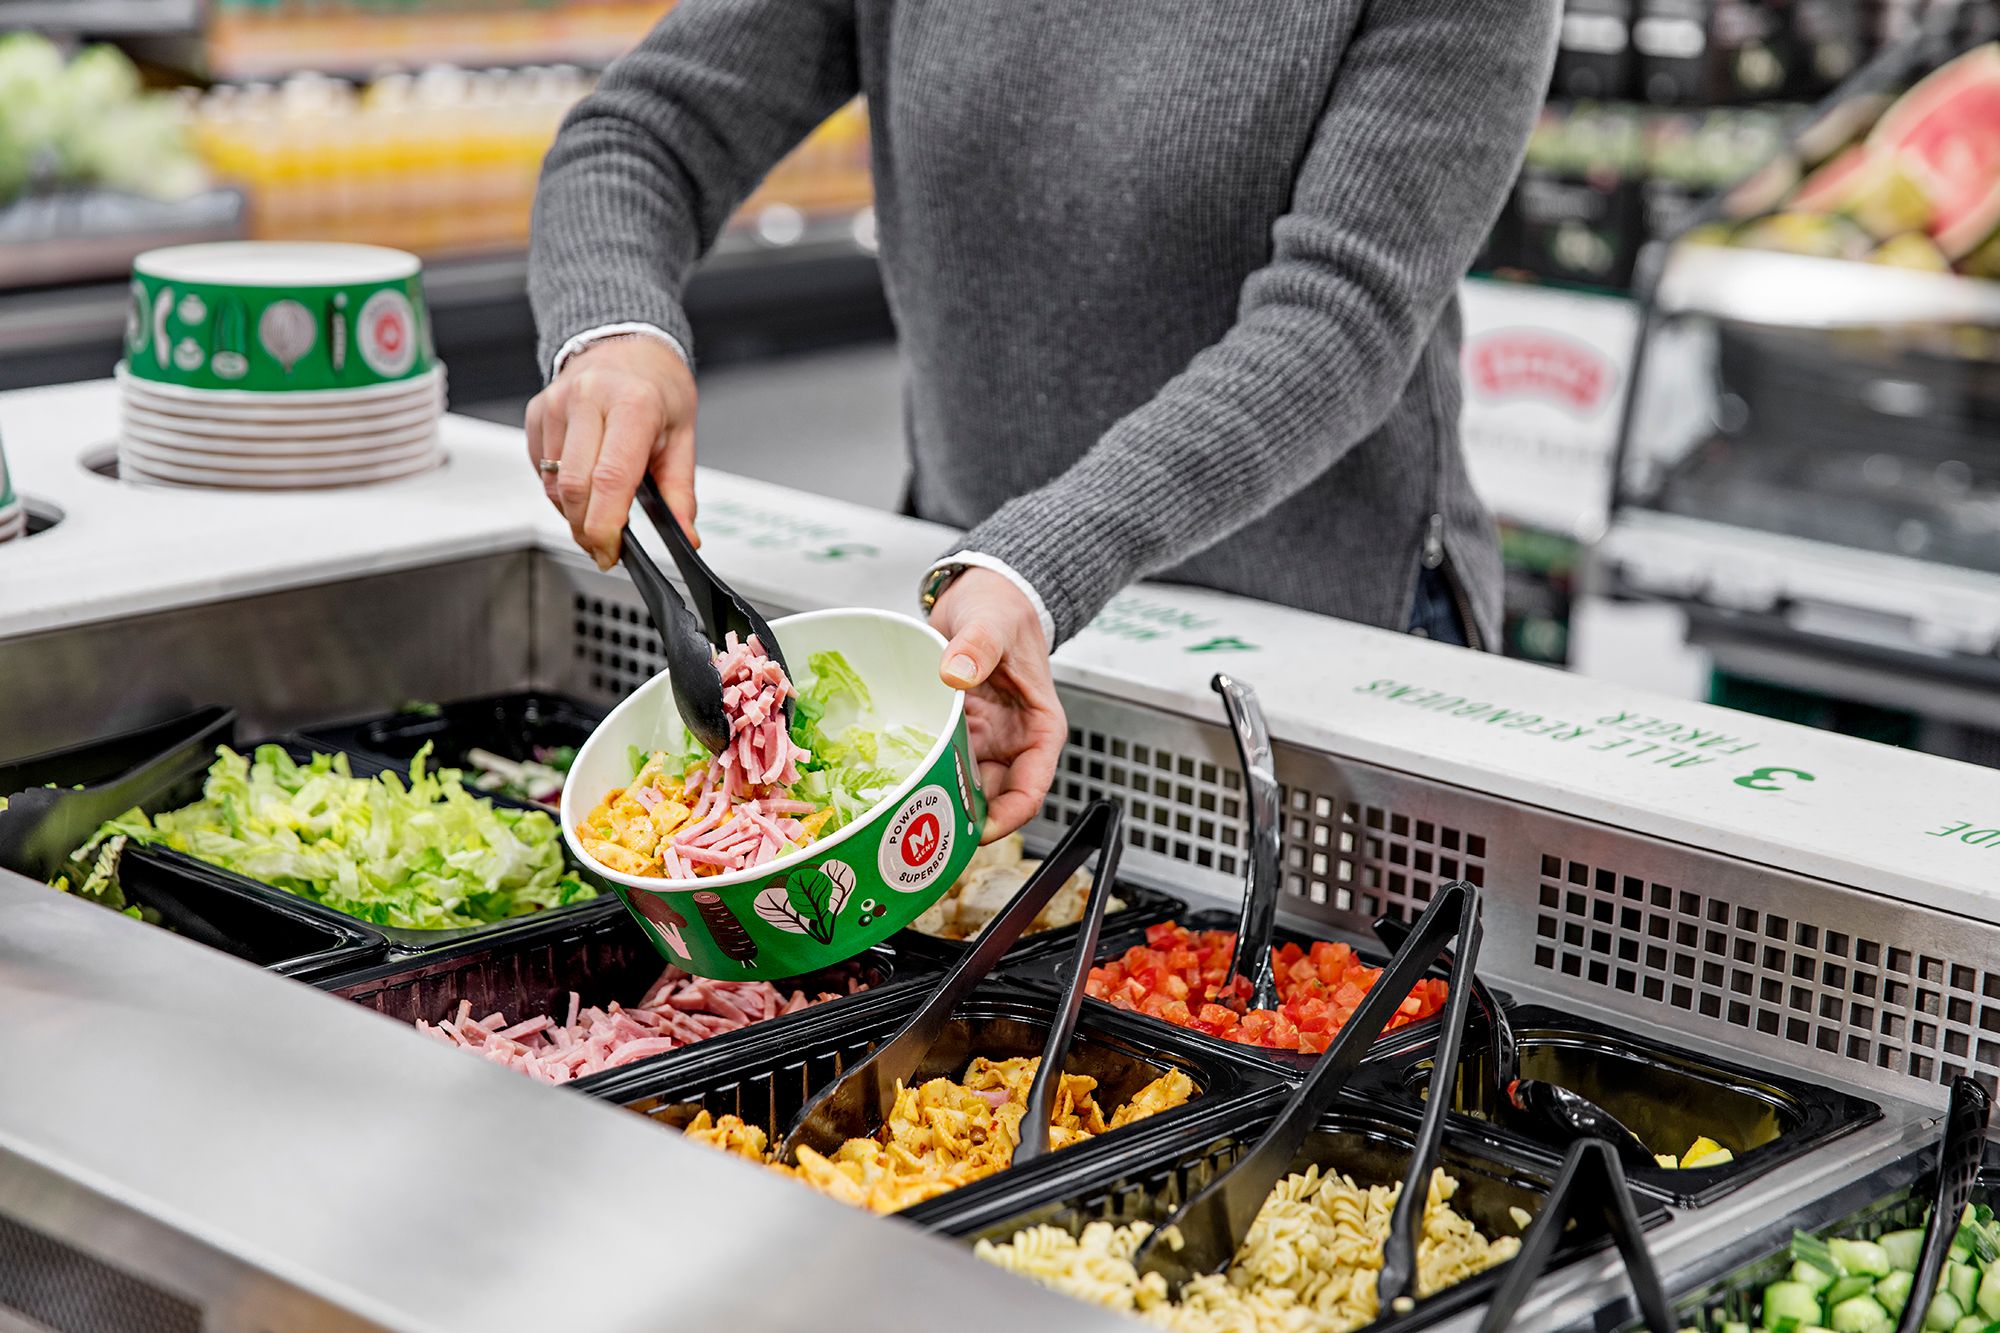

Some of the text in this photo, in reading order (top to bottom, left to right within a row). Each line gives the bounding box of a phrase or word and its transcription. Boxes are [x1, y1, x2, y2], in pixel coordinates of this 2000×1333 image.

[1353, 679, 1716, 768] ALLE REGNBUENS
[1596, 711, 1761, 755] FARGER
[1733, 766, 1816, 791] 3
[889, 796, 938, 844] POWER UP
[899, 831, 950, 883] SUPERBOWL
[914, 841, 935, 862] MENY
